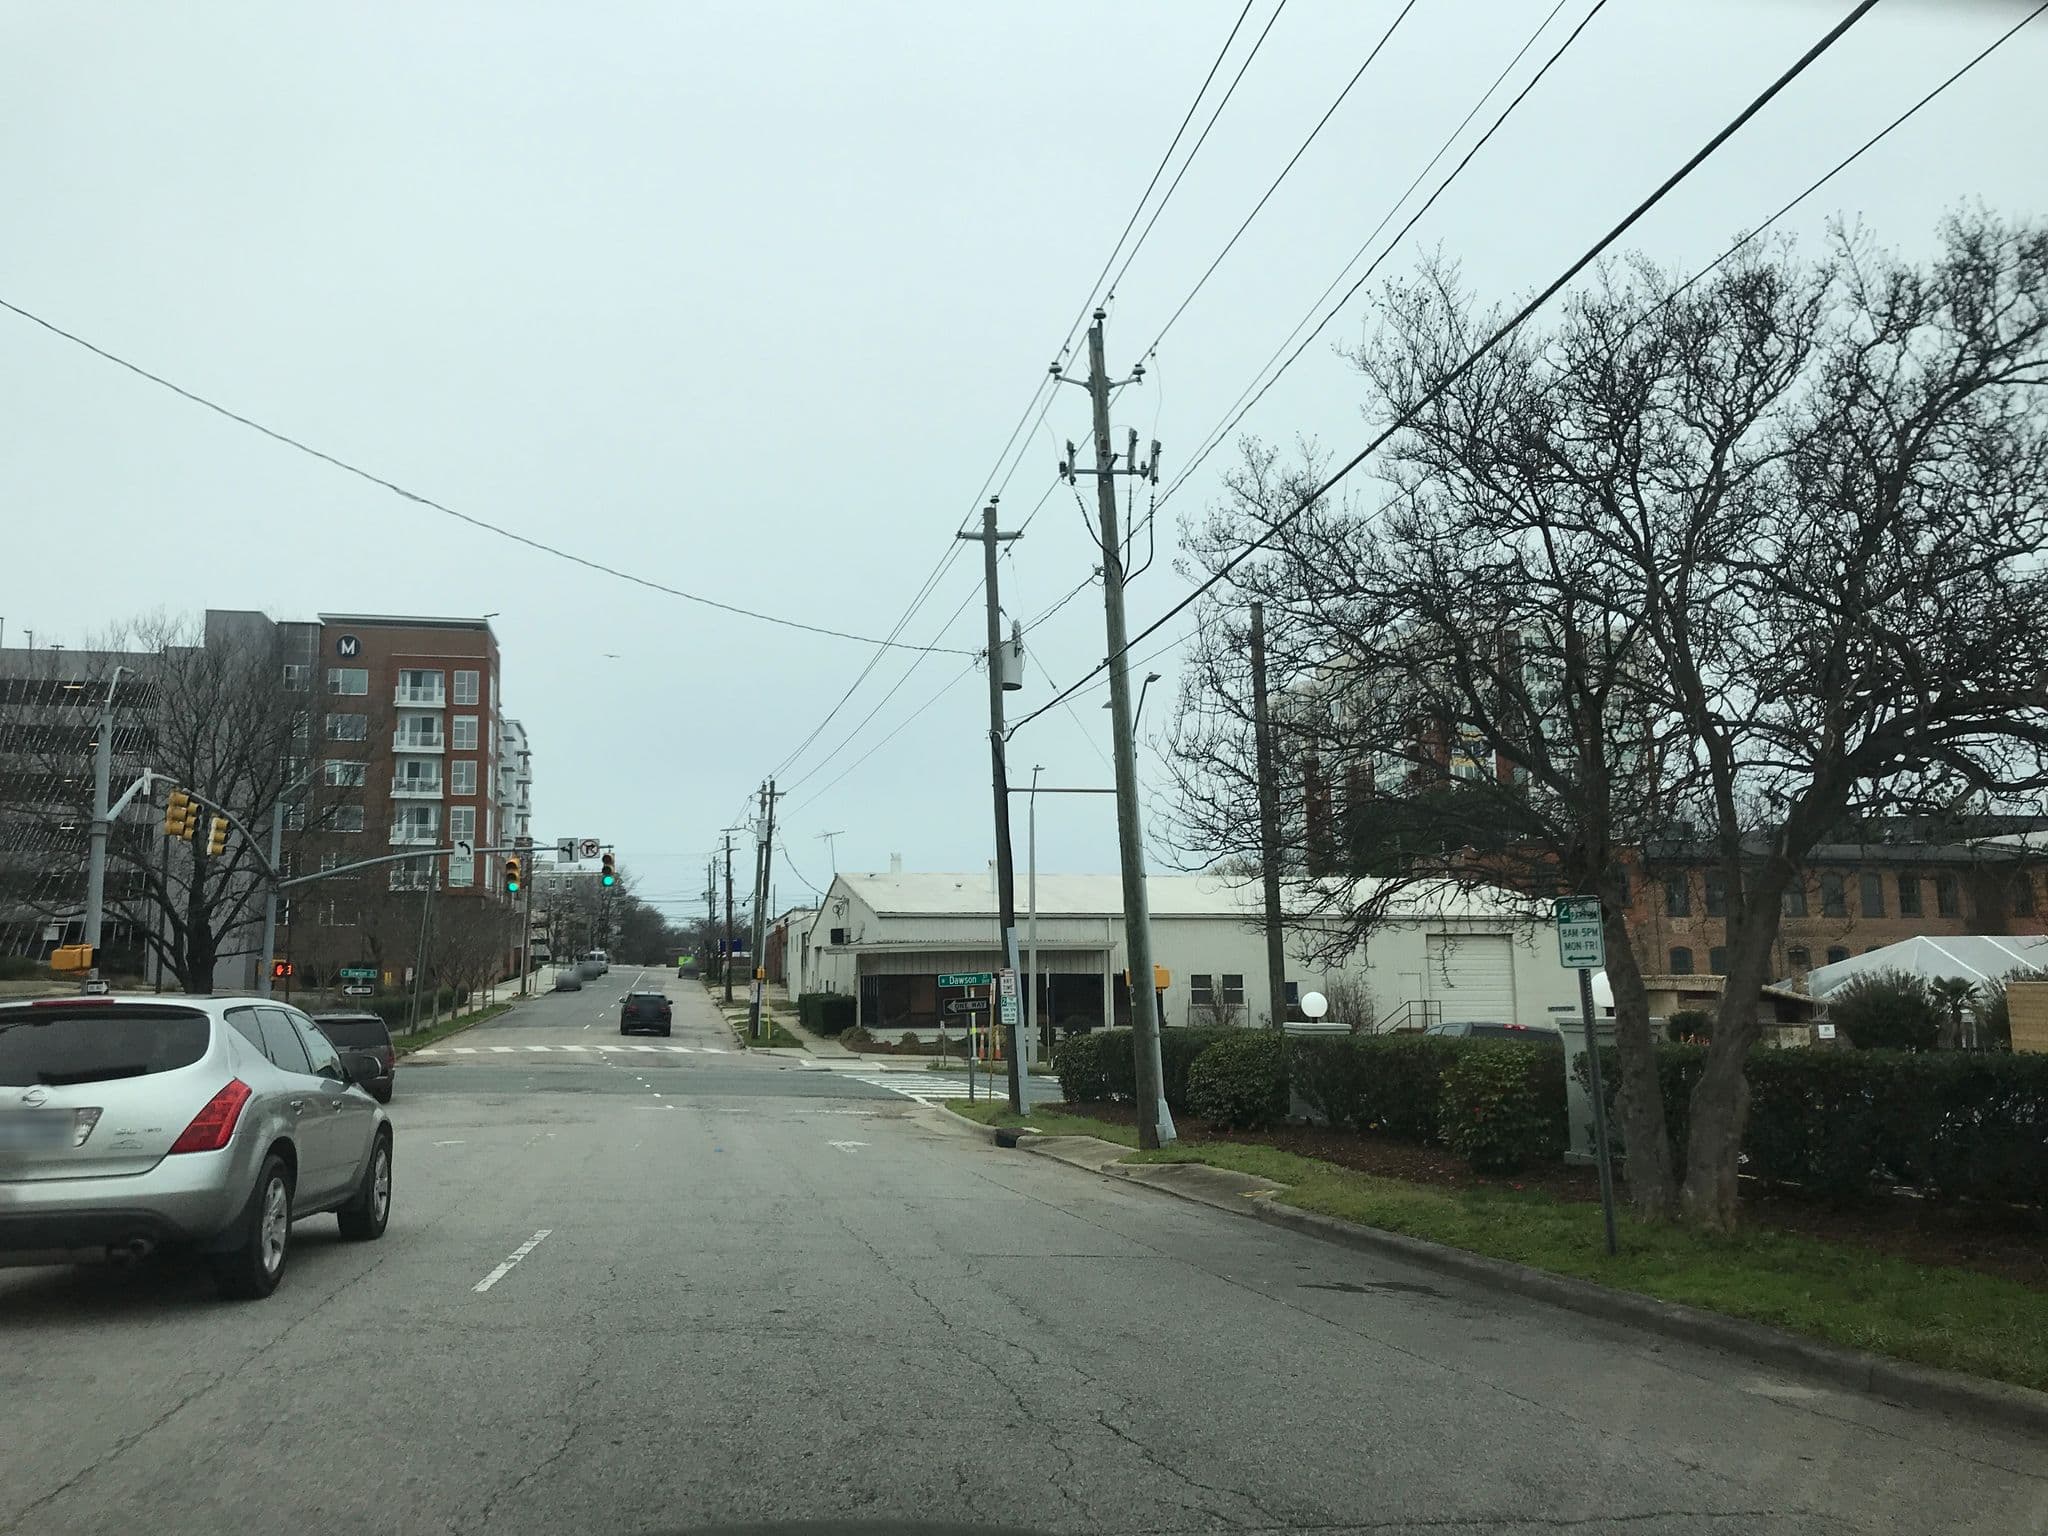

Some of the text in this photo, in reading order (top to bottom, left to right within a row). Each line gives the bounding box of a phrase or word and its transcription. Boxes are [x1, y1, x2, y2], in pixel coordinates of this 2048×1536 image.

[341, 639, 355, 655] M
[949, 976, 977, 985] Dawson
[954, 1001, 986, 1010] ONE WAY
